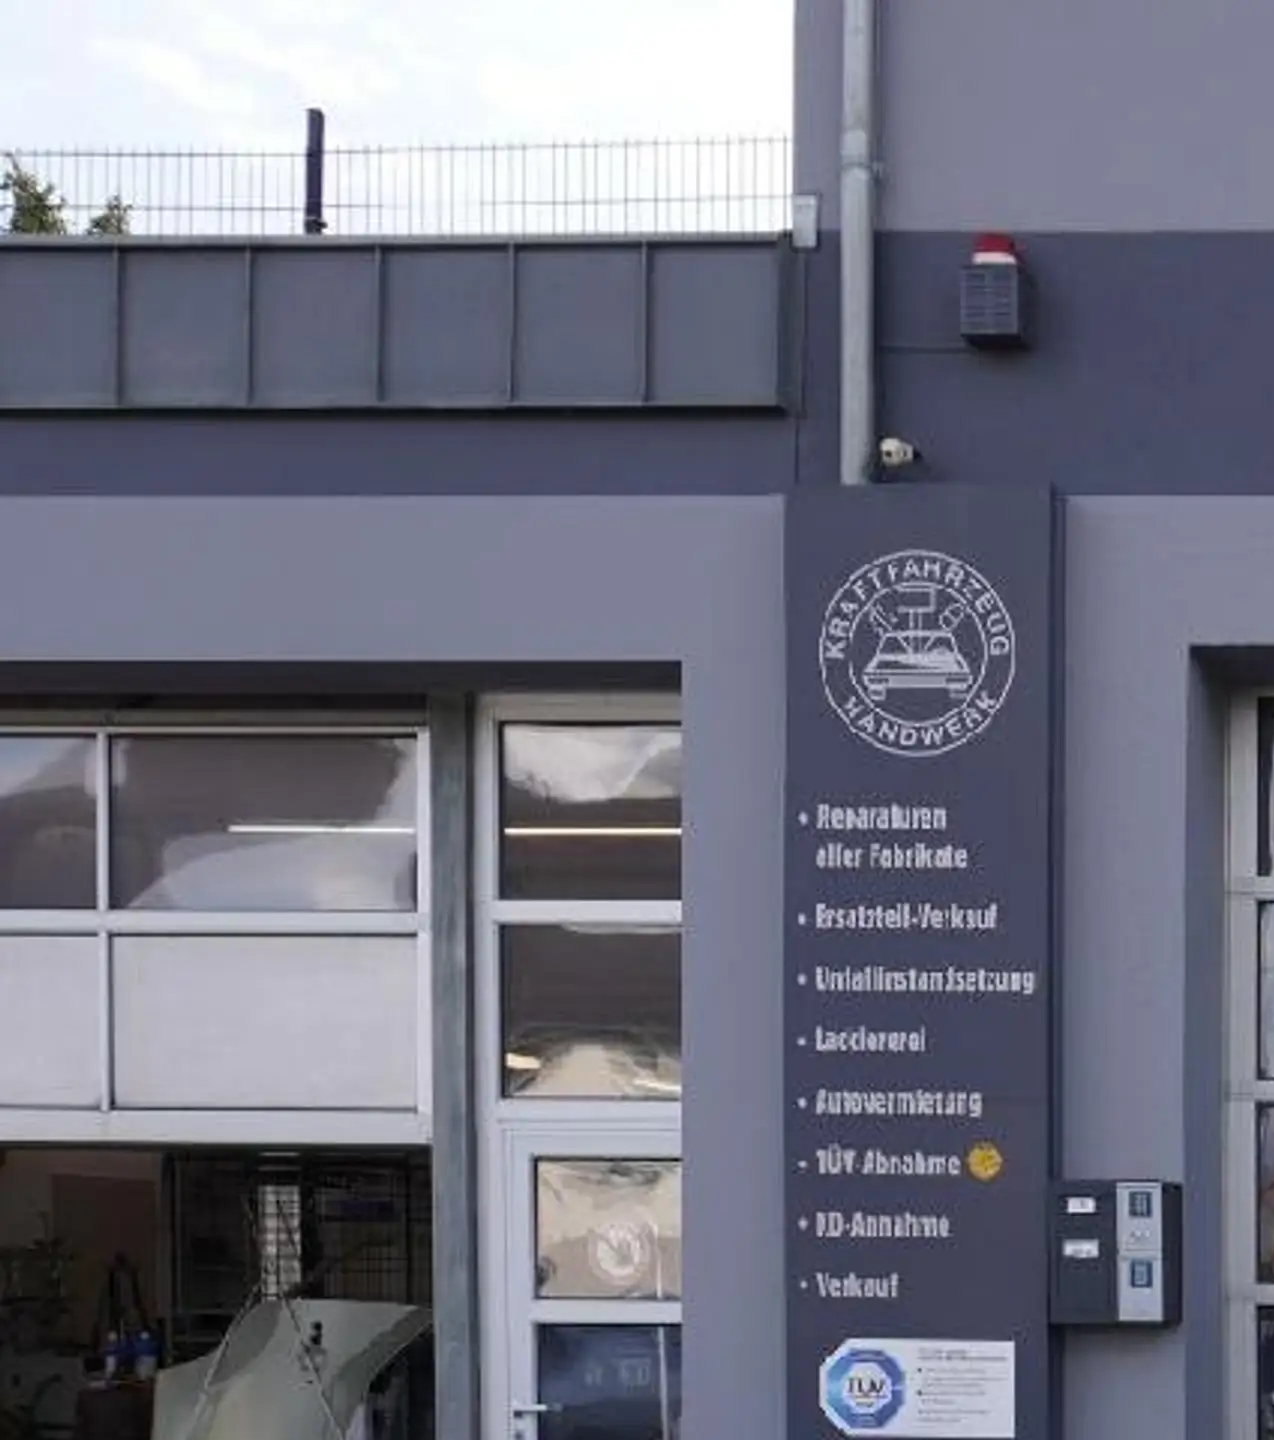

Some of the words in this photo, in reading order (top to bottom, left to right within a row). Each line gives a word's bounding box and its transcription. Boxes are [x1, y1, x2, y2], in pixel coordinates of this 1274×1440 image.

[824, 558, 1011, 660] KRAFTFAHRZEUG
[841, 688, 998, 747] HANDWERK
[815, 803, 947, 831] Reparaturen
[815, 842, 863, 869] aller
[869, 843, 969, 870] Fabrikate
[815, 903, 998, 930] Ersatzteil-Verkauf
[814, 966, 1036, 995] Unfallinstandsetzung
[814, 1088, 983, 1118] Autovermietung
[815, 1272, 900, 1299] Verkauf
